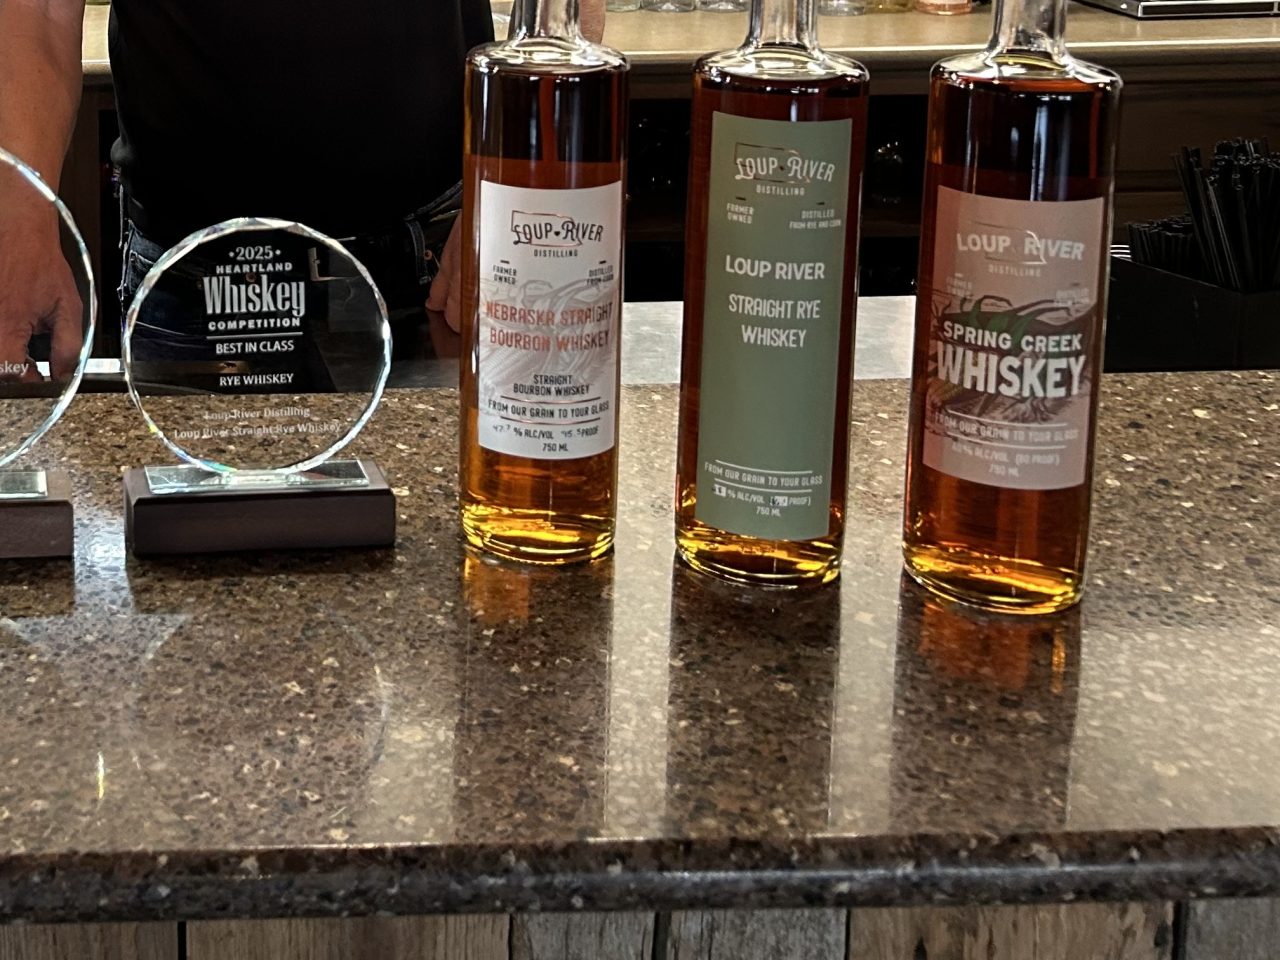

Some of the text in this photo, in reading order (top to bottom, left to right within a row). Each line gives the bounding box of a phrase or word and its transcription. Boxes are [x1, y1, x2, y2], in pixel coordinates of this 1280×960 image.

[734, 156, 836, 182] LOUP RIVER
[756, 184, 805, 196] DISTILLING
[726, 202, 754, 216] FARMER
[801, 208, 834, 219] DISTILLED
[727, 212, 752, 224] OWNED
[513, 220, 604, 246] LOUP RIVER
[236, 246, 274, 261] 2025
[534, 249, 578, 258] DISTILLING
[956, 233, 1085, 261] LOUP RIVER
[216, 262, 293, 274] HEARTLAND
[493, 264, 517, 277] FARMER
[725, 254, 825, 281] LOUP RIVER
[494, 274, 516, 285] OWNED
[202, 275, 306, 317] Whiskey
[728, 292, 820, 320] STRAIGHT RYE
[486, 301, 613, 326] NEBRASKA STRAIGHT
[208, 318, 300, 331] COMPETITION
[490, 327, 610, 352] BOURBON WHISKEY
[740, 324, 806, 348] WHISKEY
[942, 320, 1083, 353] SPRING CREEK
[216, 340, 295, 354] BEST IN CLASS
[936, 340, 1086, 399] WHISKEY
[219, 373, 294, 387] RYE WHISKEY
[534, 374, 574, 385] STRAIGHT
[514, 383, 590, 396] BOURBON WHISKEY
[234, 409, 261, 419] River
[264, 407, 310, 418] Distilling
[488, 399, 508, 412] FROM
[511, 405, 526, 416] OUR
[530, 408, 554, 418] GRAIN
[558, 408, 568, 418] TO
[570, 406, 589, 418] YOUR
[935, 411, 957, 429] FROM
[959, 421, 978, 434] OUR
[174, 429, 200, 440] Loup
[232, 424, 272, 438] Straight
[513, 427, 522, 437] %
[524, 428, 554, 440] ALC/VOL
[542, 442, 568, 452] 750 ML
[704, 462, 723, 476] FROM
[725, 469, 740, 480] OUR
[742, 472, 766, 485] GRAIN
[768, 476, 778, 486] TO
[780, 477, 800, 486] YOUR
[756, 506, 770, 516] 750
